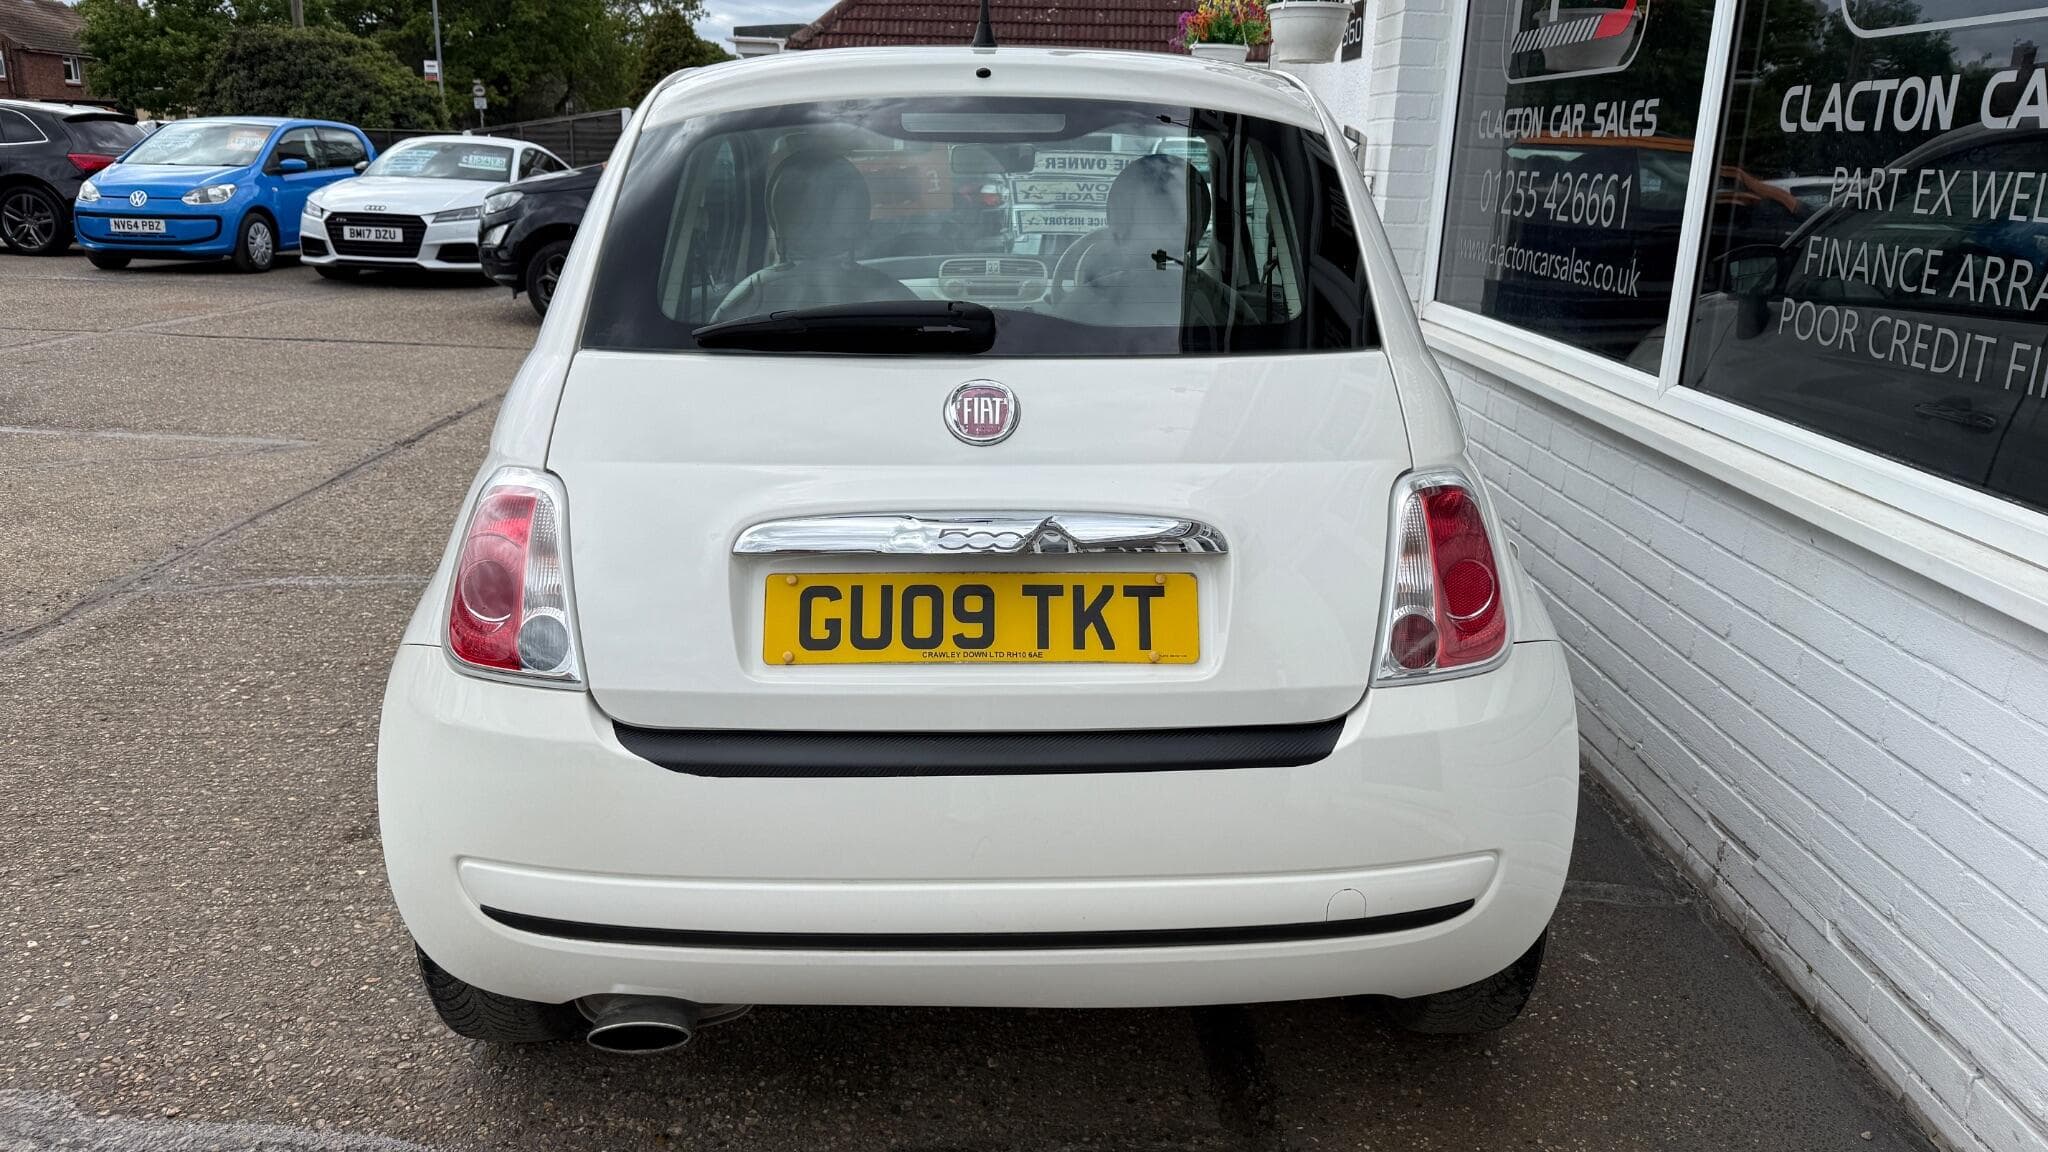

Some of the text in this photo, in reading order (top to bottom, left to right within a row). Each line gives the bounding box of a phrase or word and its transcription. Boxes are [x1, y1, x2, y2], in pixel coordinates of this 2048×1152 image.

[1478, 98, 1660, 139] CLACTON CAR SALES
[1780, 73, 1961, 133] CLACTON
[1480, 169, 1540, 218] 01255
[1543, 171, 1633, 230] 426661
[1828, 166, 1907, 212] PART
[1913, 169, 1961, 217] EX
[113, 220, 161, 231] NV64 PBZ
[349, 227, 396, 240] BM17 DZU
[1460, 235, 1641, 298] www.clactoncarsales.co.uk
[1803, 235, 1944, 295] FINANCE
[1778, 297, 2048, 399] POOR CREDIT FI
[963, 397, 1003, 425] FIAT
[938, 528, 1025, 551] 500
[799, 584, 1165, 651] GU09 TKT
[922, 651, 961, 659] CRAWLEY
[963, 651, 988, 659] DOWN
[989, 651, 1005, 659] LTD
[1006, 651, 1027, 659] RH10
